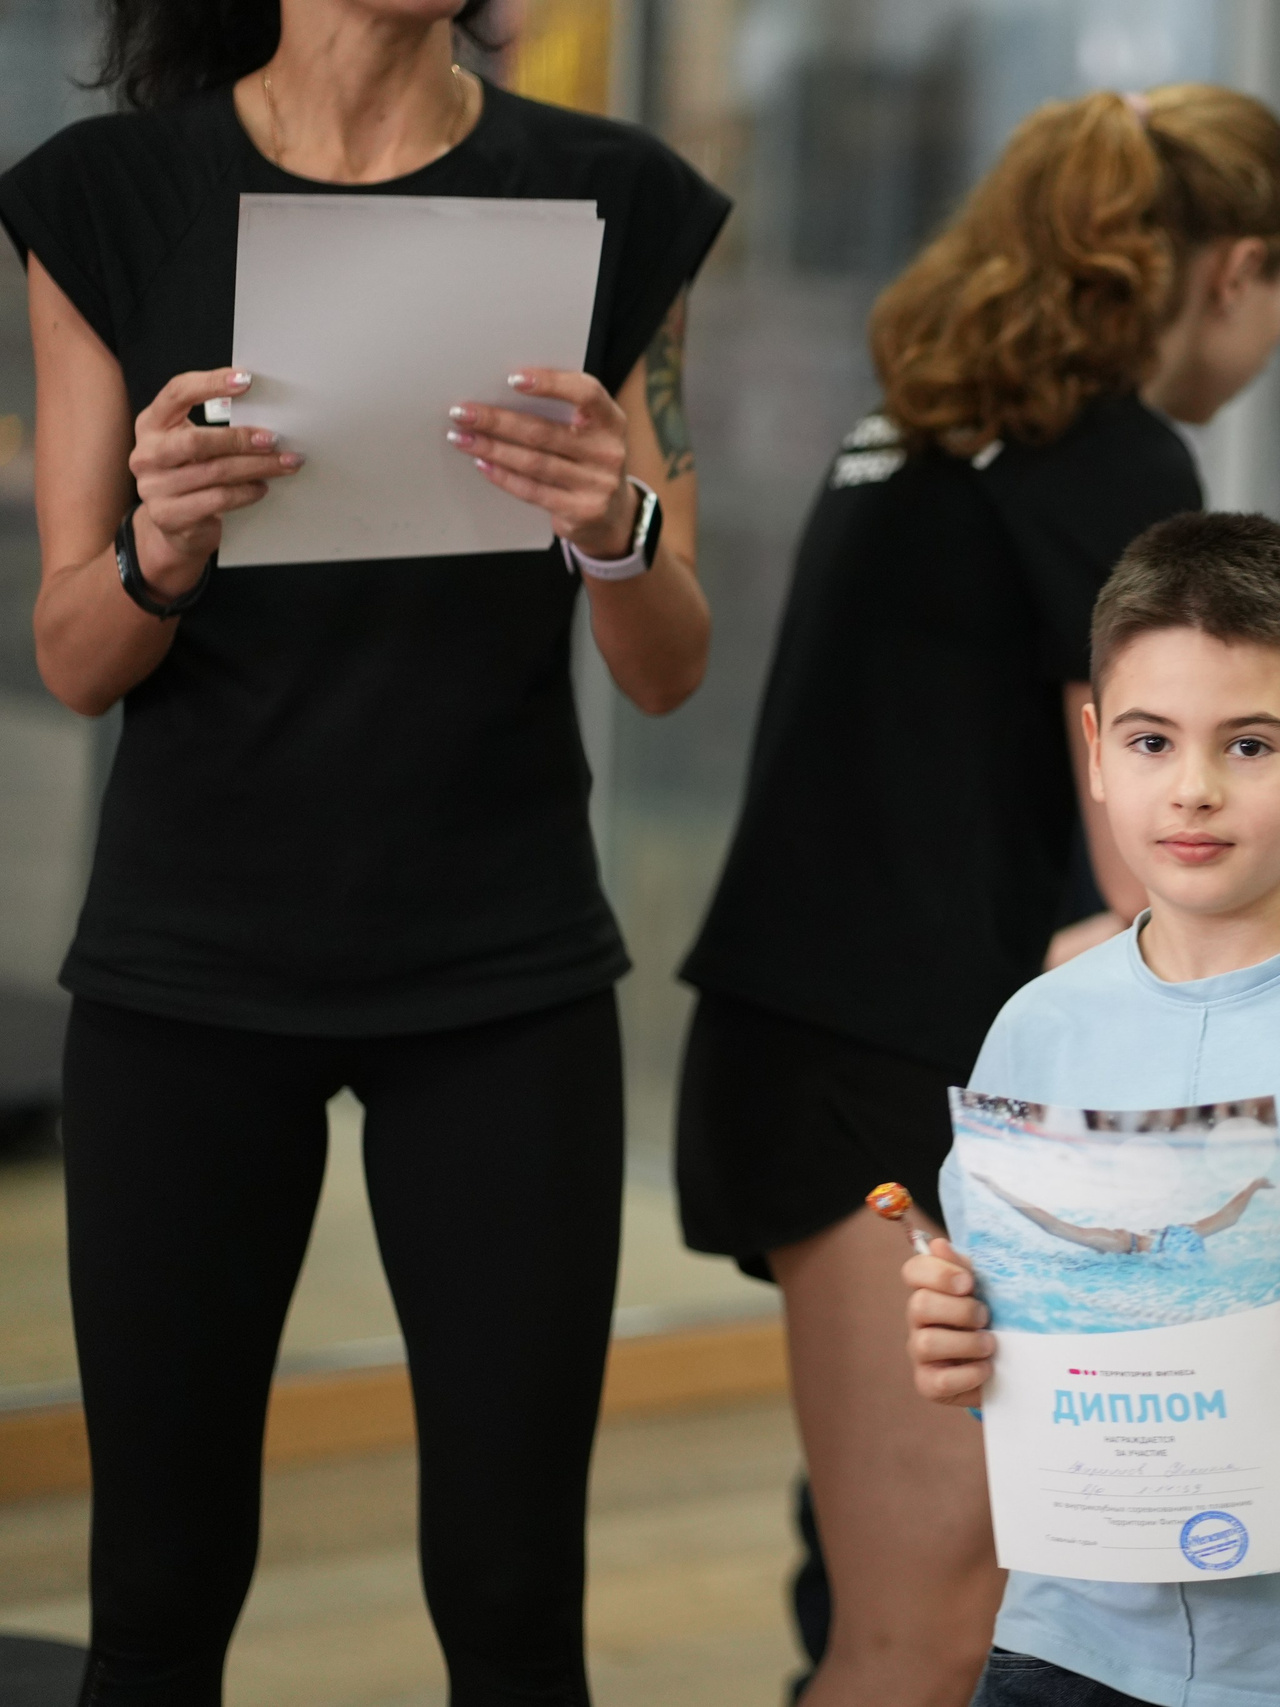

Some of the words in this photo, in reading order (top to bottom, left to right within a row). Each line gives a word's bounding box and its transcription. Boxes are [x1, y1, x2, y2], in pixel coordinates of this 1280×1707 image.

[1099, 1370, 1152, 1378] ТЕРРИТОРИЯ
[1155, 1369, 1196, 1377] ФИТНЕСА
[1052, 1388, 1227, 1426] ДИПЛОМ
[1104, 1435, 1176, 1444] НАГРАЖДАЕТСЯ
[1114, 1449, 1126, 1457] ЗА
[1128, 1449, 1168, 1457] УЧАСТИЕ
